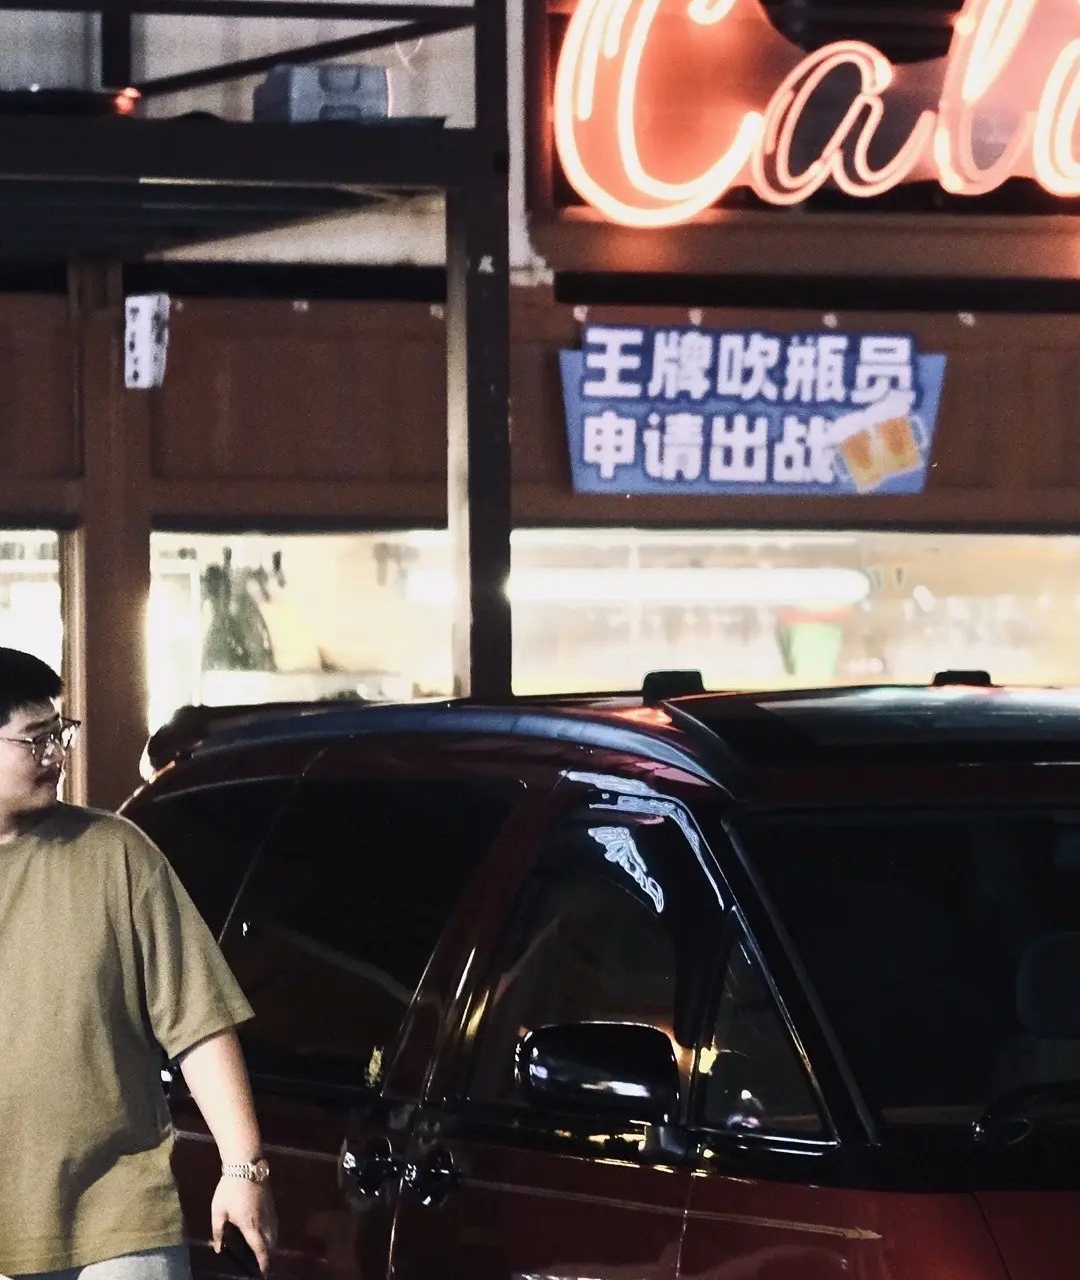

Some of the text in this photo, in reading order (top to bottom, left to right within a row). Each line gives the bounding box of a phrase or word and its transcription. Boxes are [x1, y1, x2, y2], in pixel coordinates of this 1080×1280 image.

[582, 327, 916, 405] 王牌吹瓶员
[583, 411, 840, 484] 申请出战
